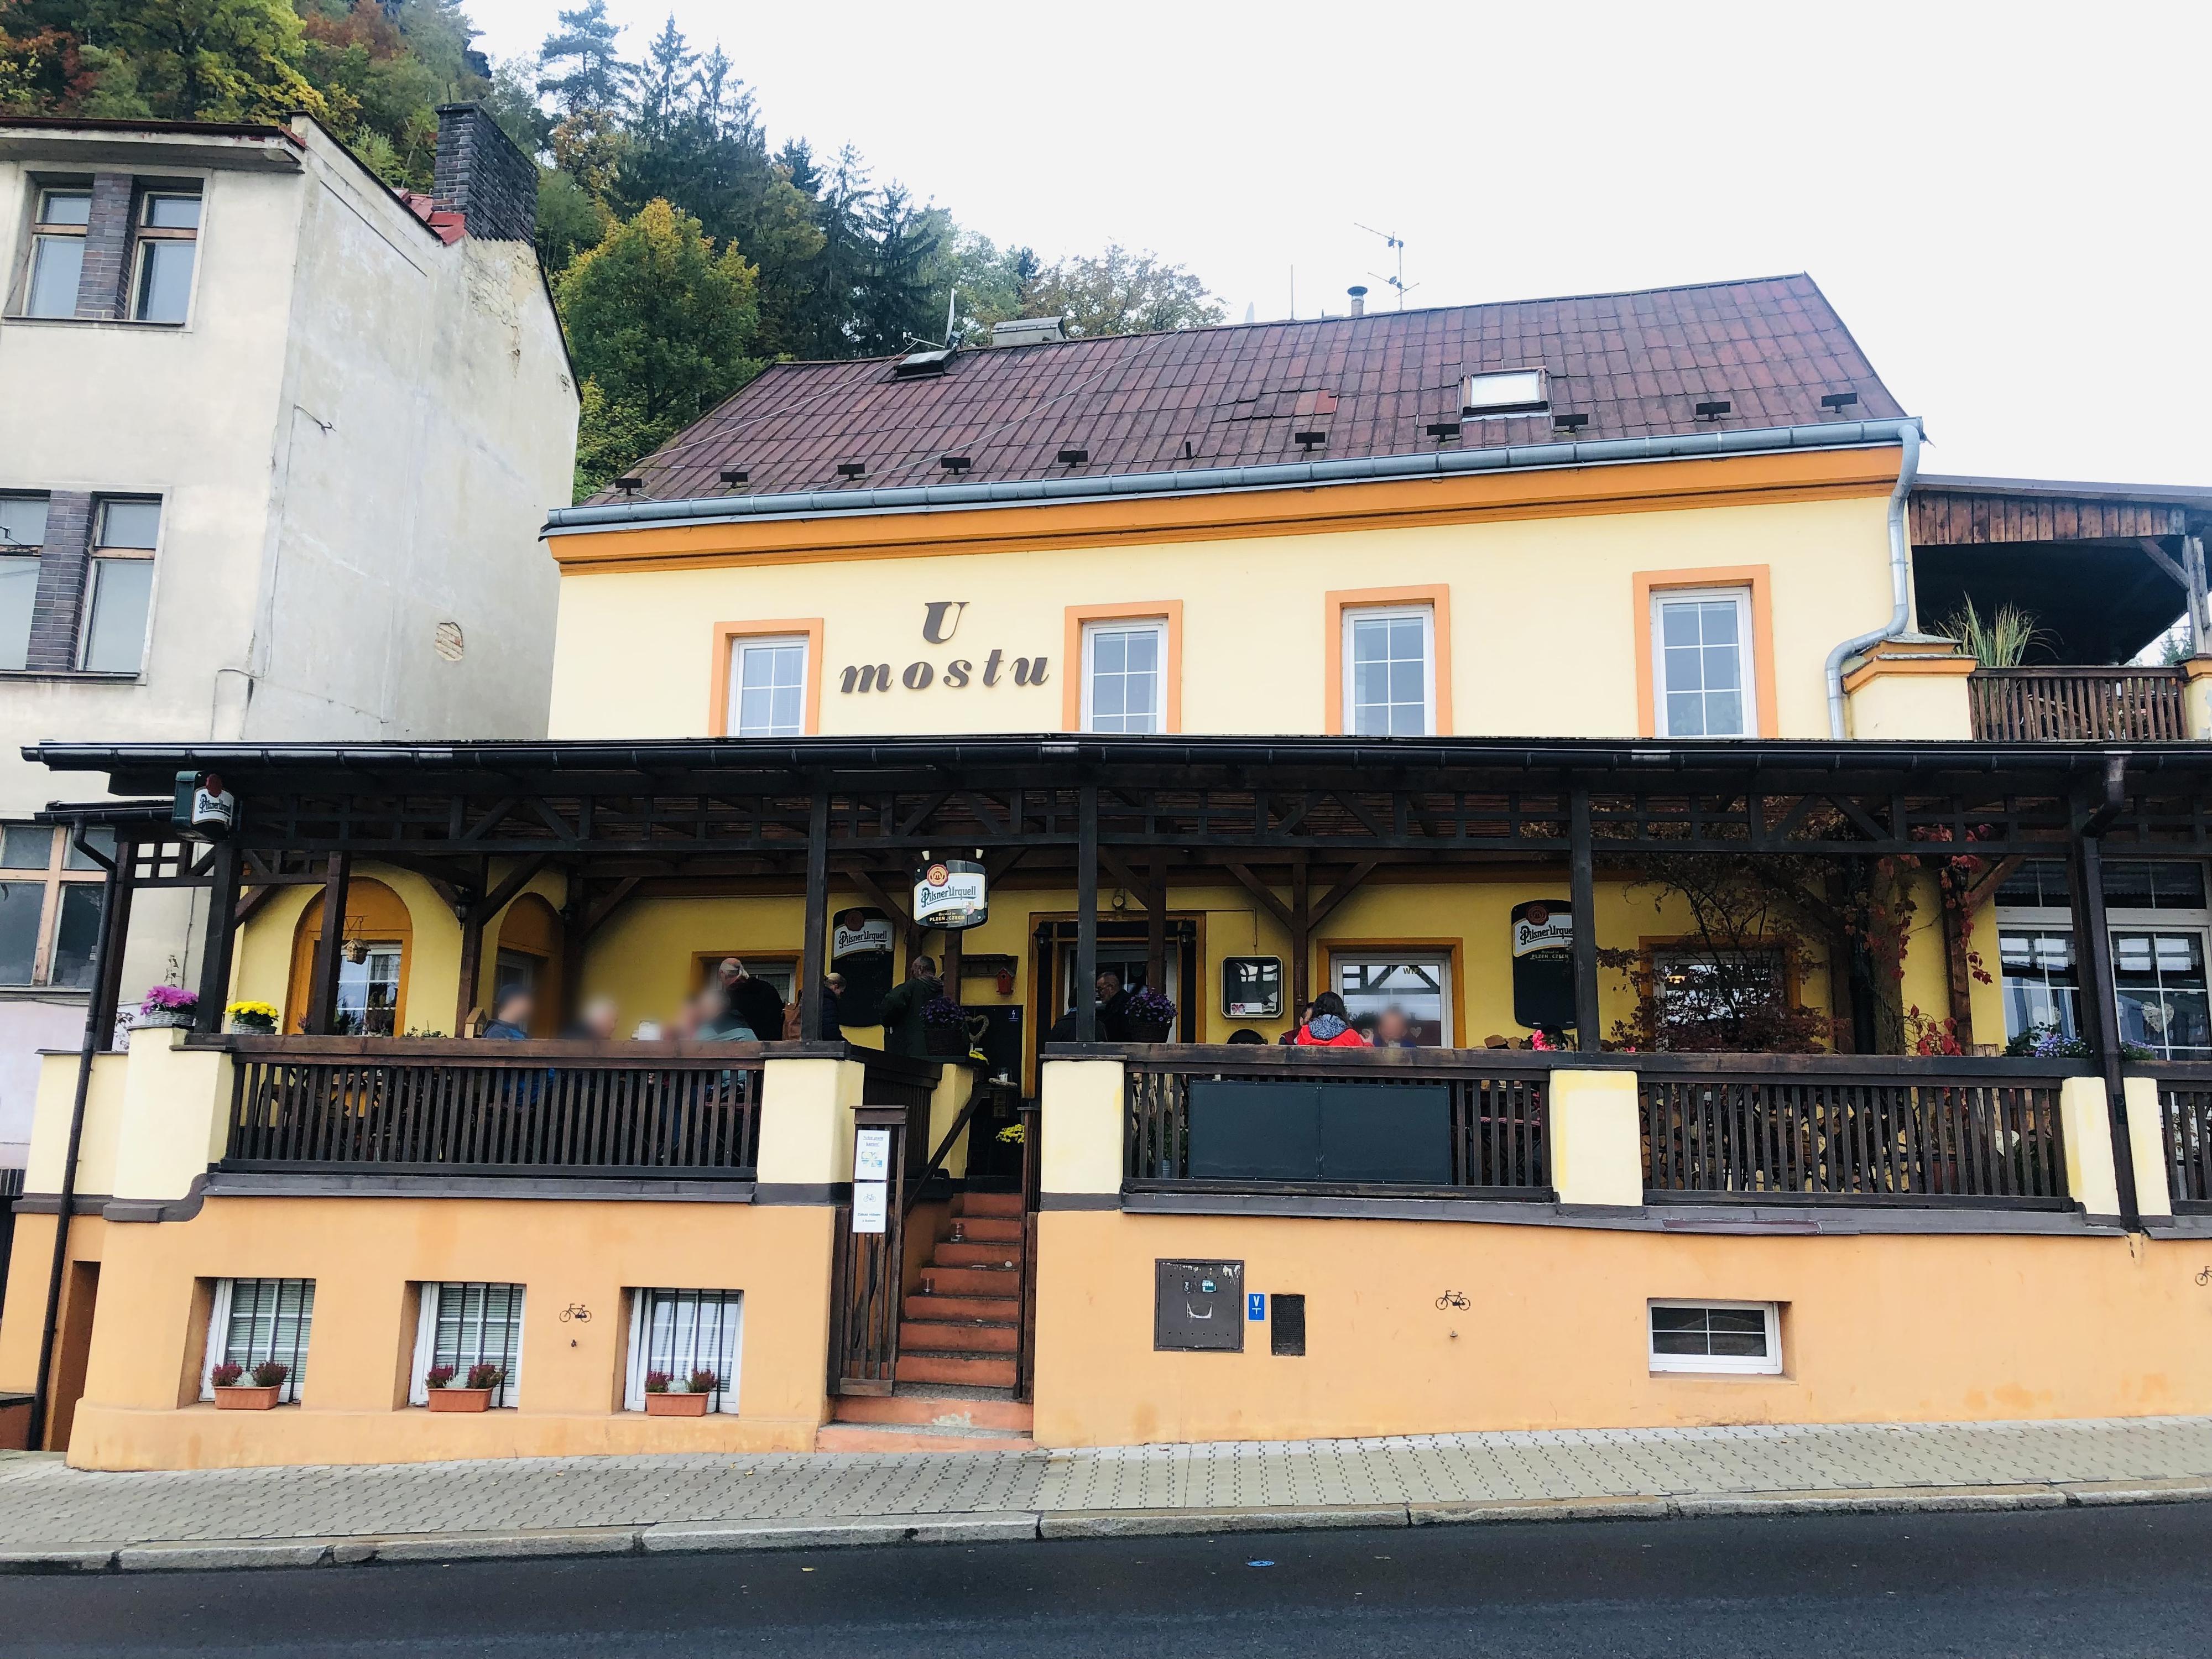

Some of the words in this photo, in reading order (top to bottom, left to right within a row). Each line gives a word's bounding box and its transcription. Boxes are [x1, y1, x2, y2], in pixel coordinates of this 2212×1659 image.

[923, 601, 970, 644] U
[839, 649, 1050, 693] mostu
[921, 887, 948, 907] Pilsner
[948, 885, 976, 900] Urquell
[839, 931, 863, 949] Pilsner
[863, 930, 887, 943] Urquell
[1520, 925, 1550, 946] Pilsner
[1549, 924, 1573, 939] Urque
[1253, 1295, 1260, 1307] V
